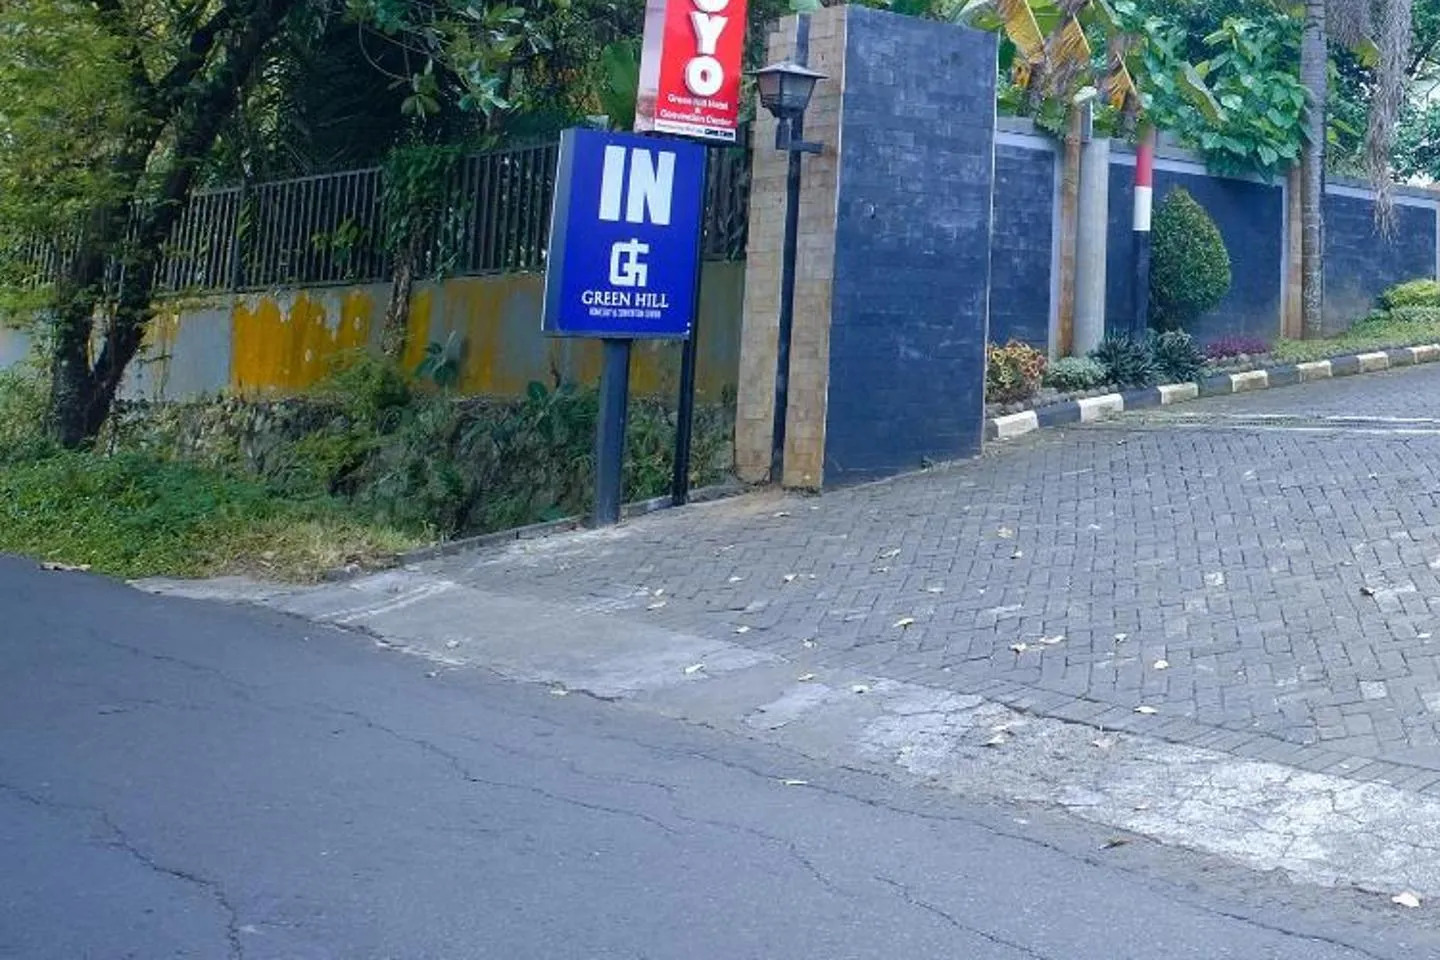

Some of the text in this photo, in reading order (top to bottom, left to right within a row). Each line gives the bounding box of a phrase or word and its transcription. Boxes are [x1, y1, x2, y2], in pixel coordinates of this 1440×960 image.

[599, 145, 677, 226] IN
[581, 290, 669, 309] GREEN HILL
